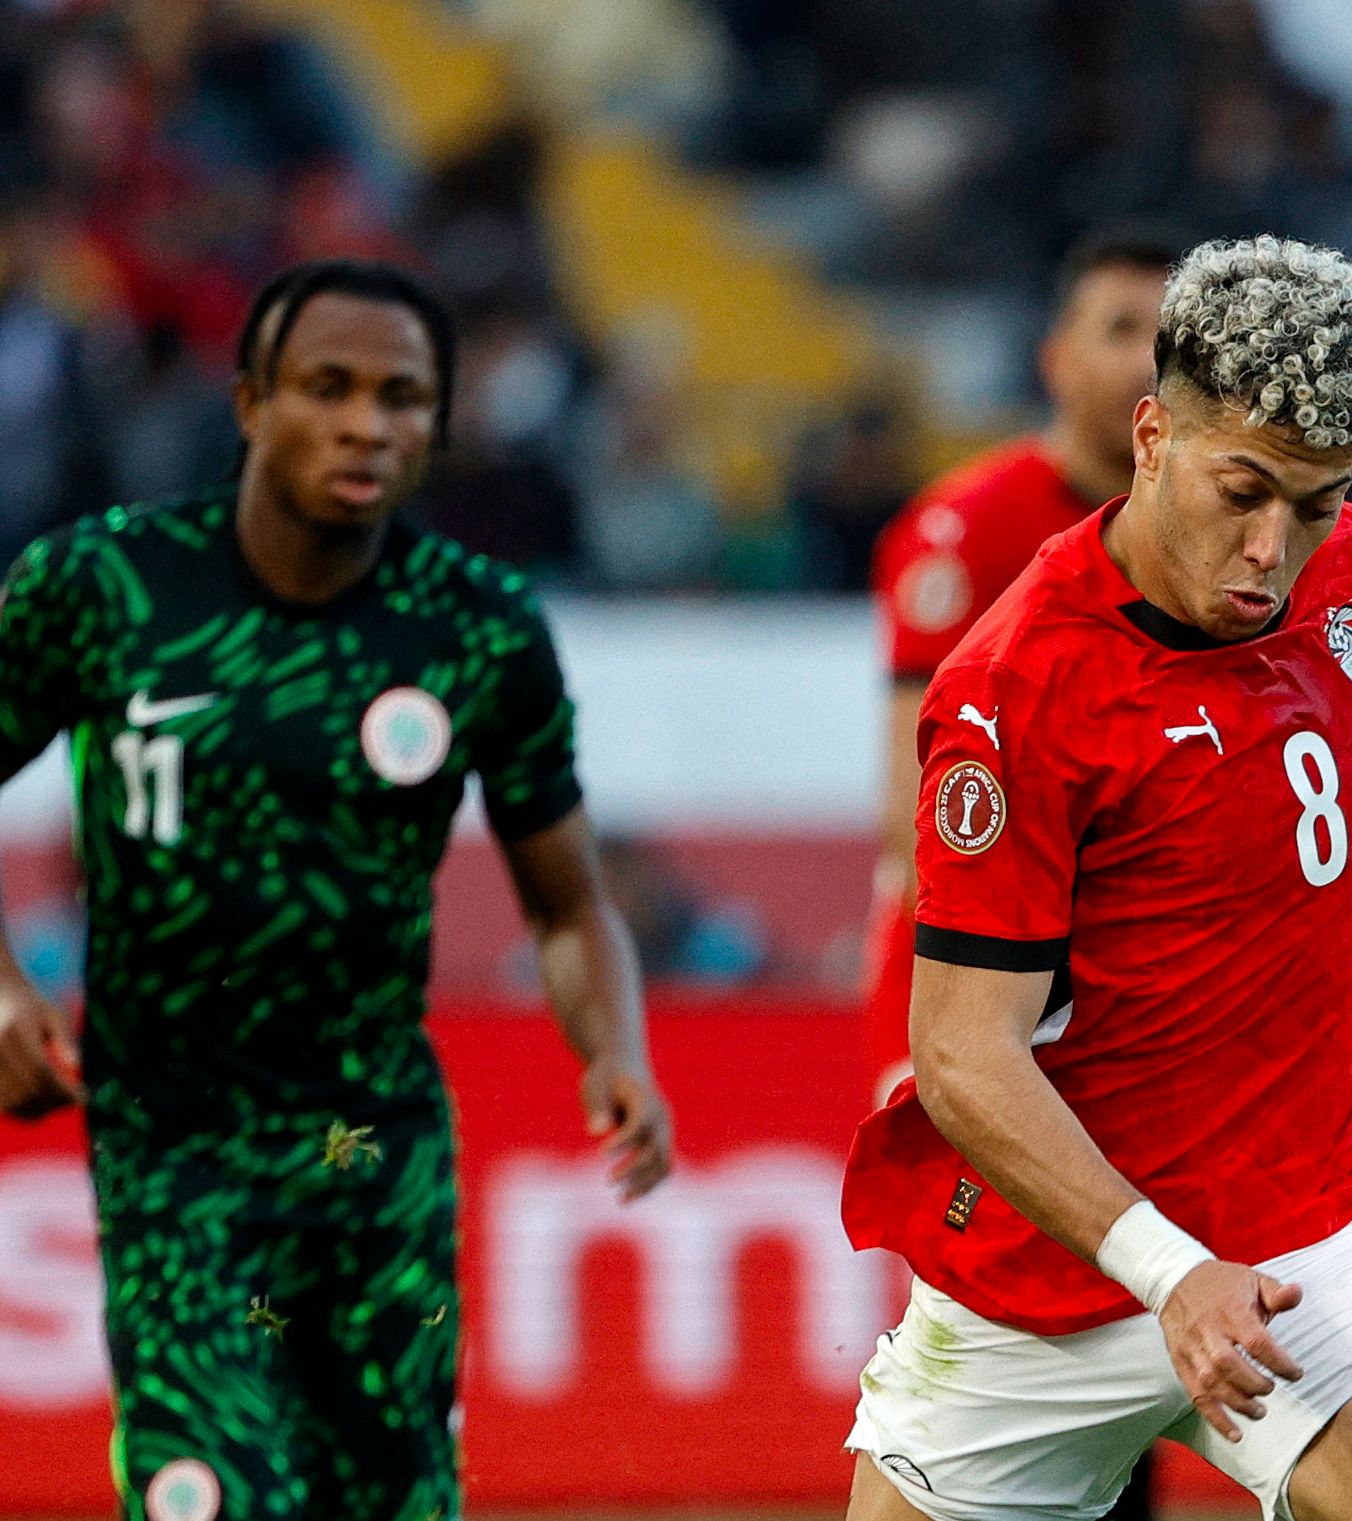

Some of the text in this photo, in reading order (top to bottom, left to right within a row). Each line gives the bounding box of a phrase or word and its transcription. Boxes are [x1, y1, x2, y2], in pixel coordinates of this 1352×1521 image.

[111, 730, 184, 848] 11
[943, 770, 962, 794] CAF
[990, 793, 1000, 812] CUP
[1283, 731, 1348, 887] 8
[990, 813, 999, 828] OF
